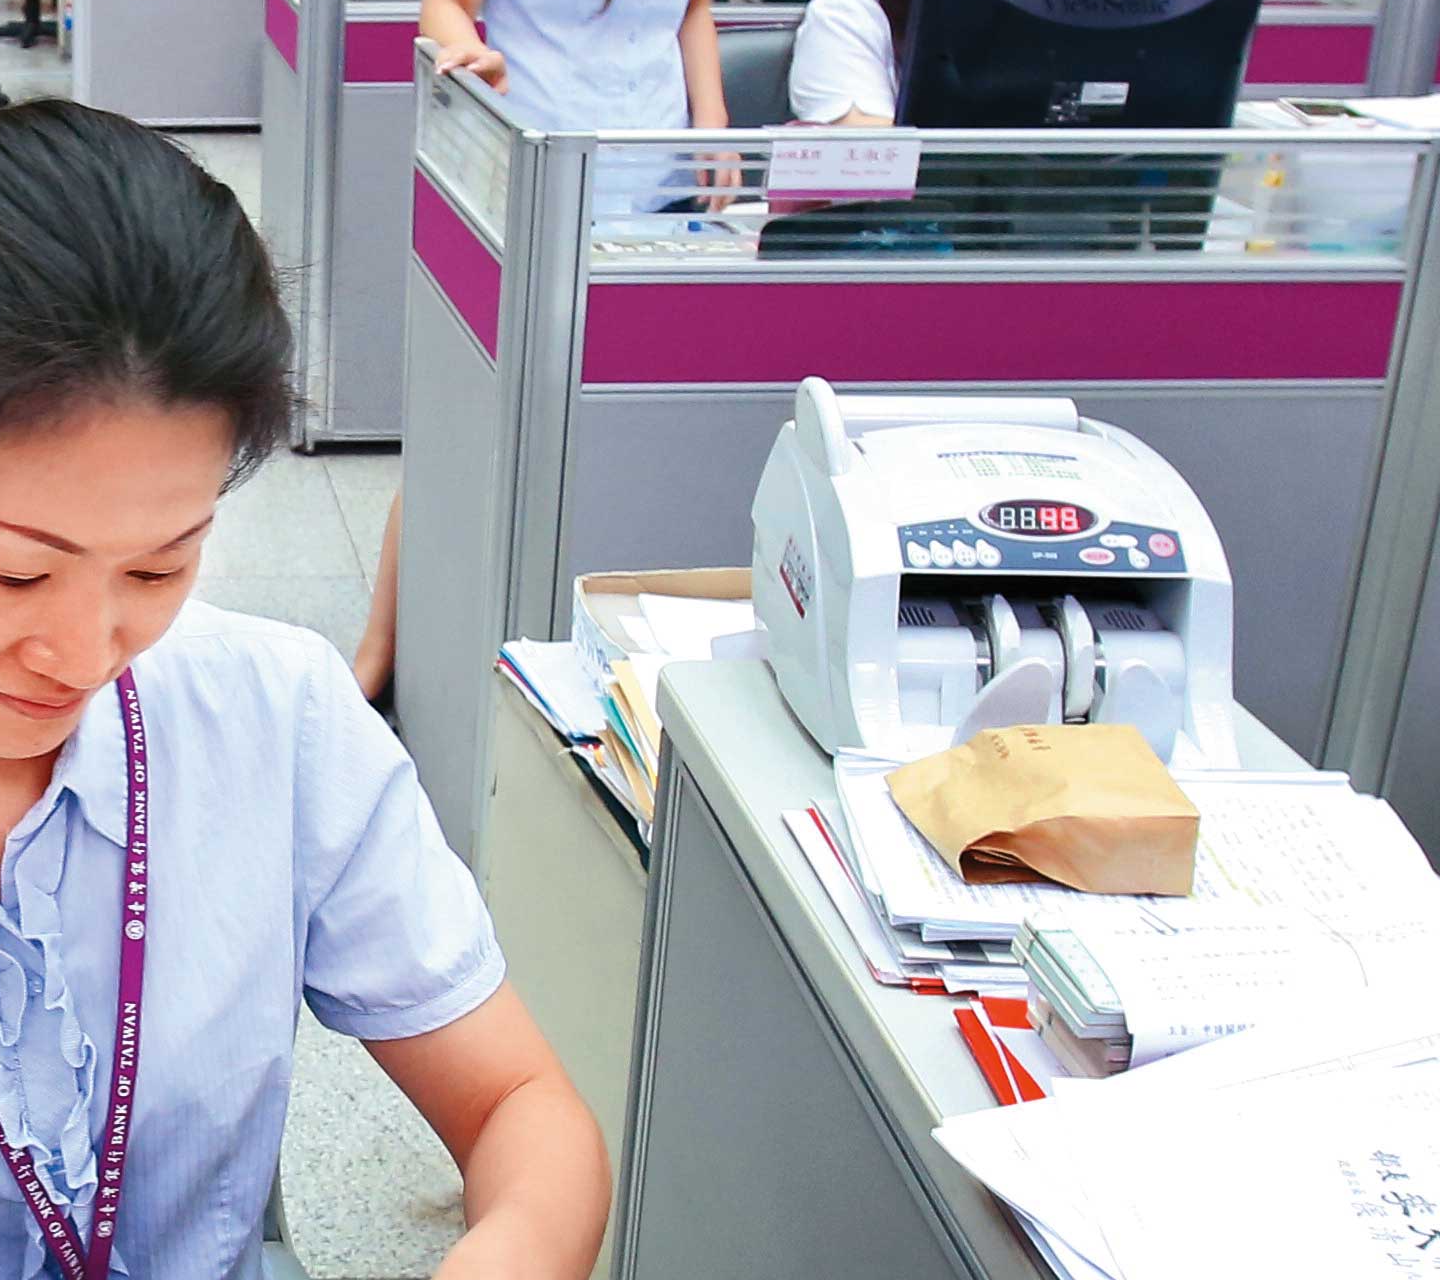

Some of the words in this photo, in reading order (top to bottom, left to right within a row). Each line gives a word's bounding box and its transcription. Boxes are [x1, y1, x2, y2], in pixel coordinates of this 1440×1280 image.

[128, 688, 144, 753] TAIWAN
[134, 758, 146, 783] OF
[132, 790, 147, 837] BANK
[120, 1000, 139, 1070] TAIWAN
[116, 1074, 132, 1097] OF
[110, 1102, 129, 1147] BANK
[24, 1177, 57, 1222] BANK
[48, 1219, 67, 1243] OF
